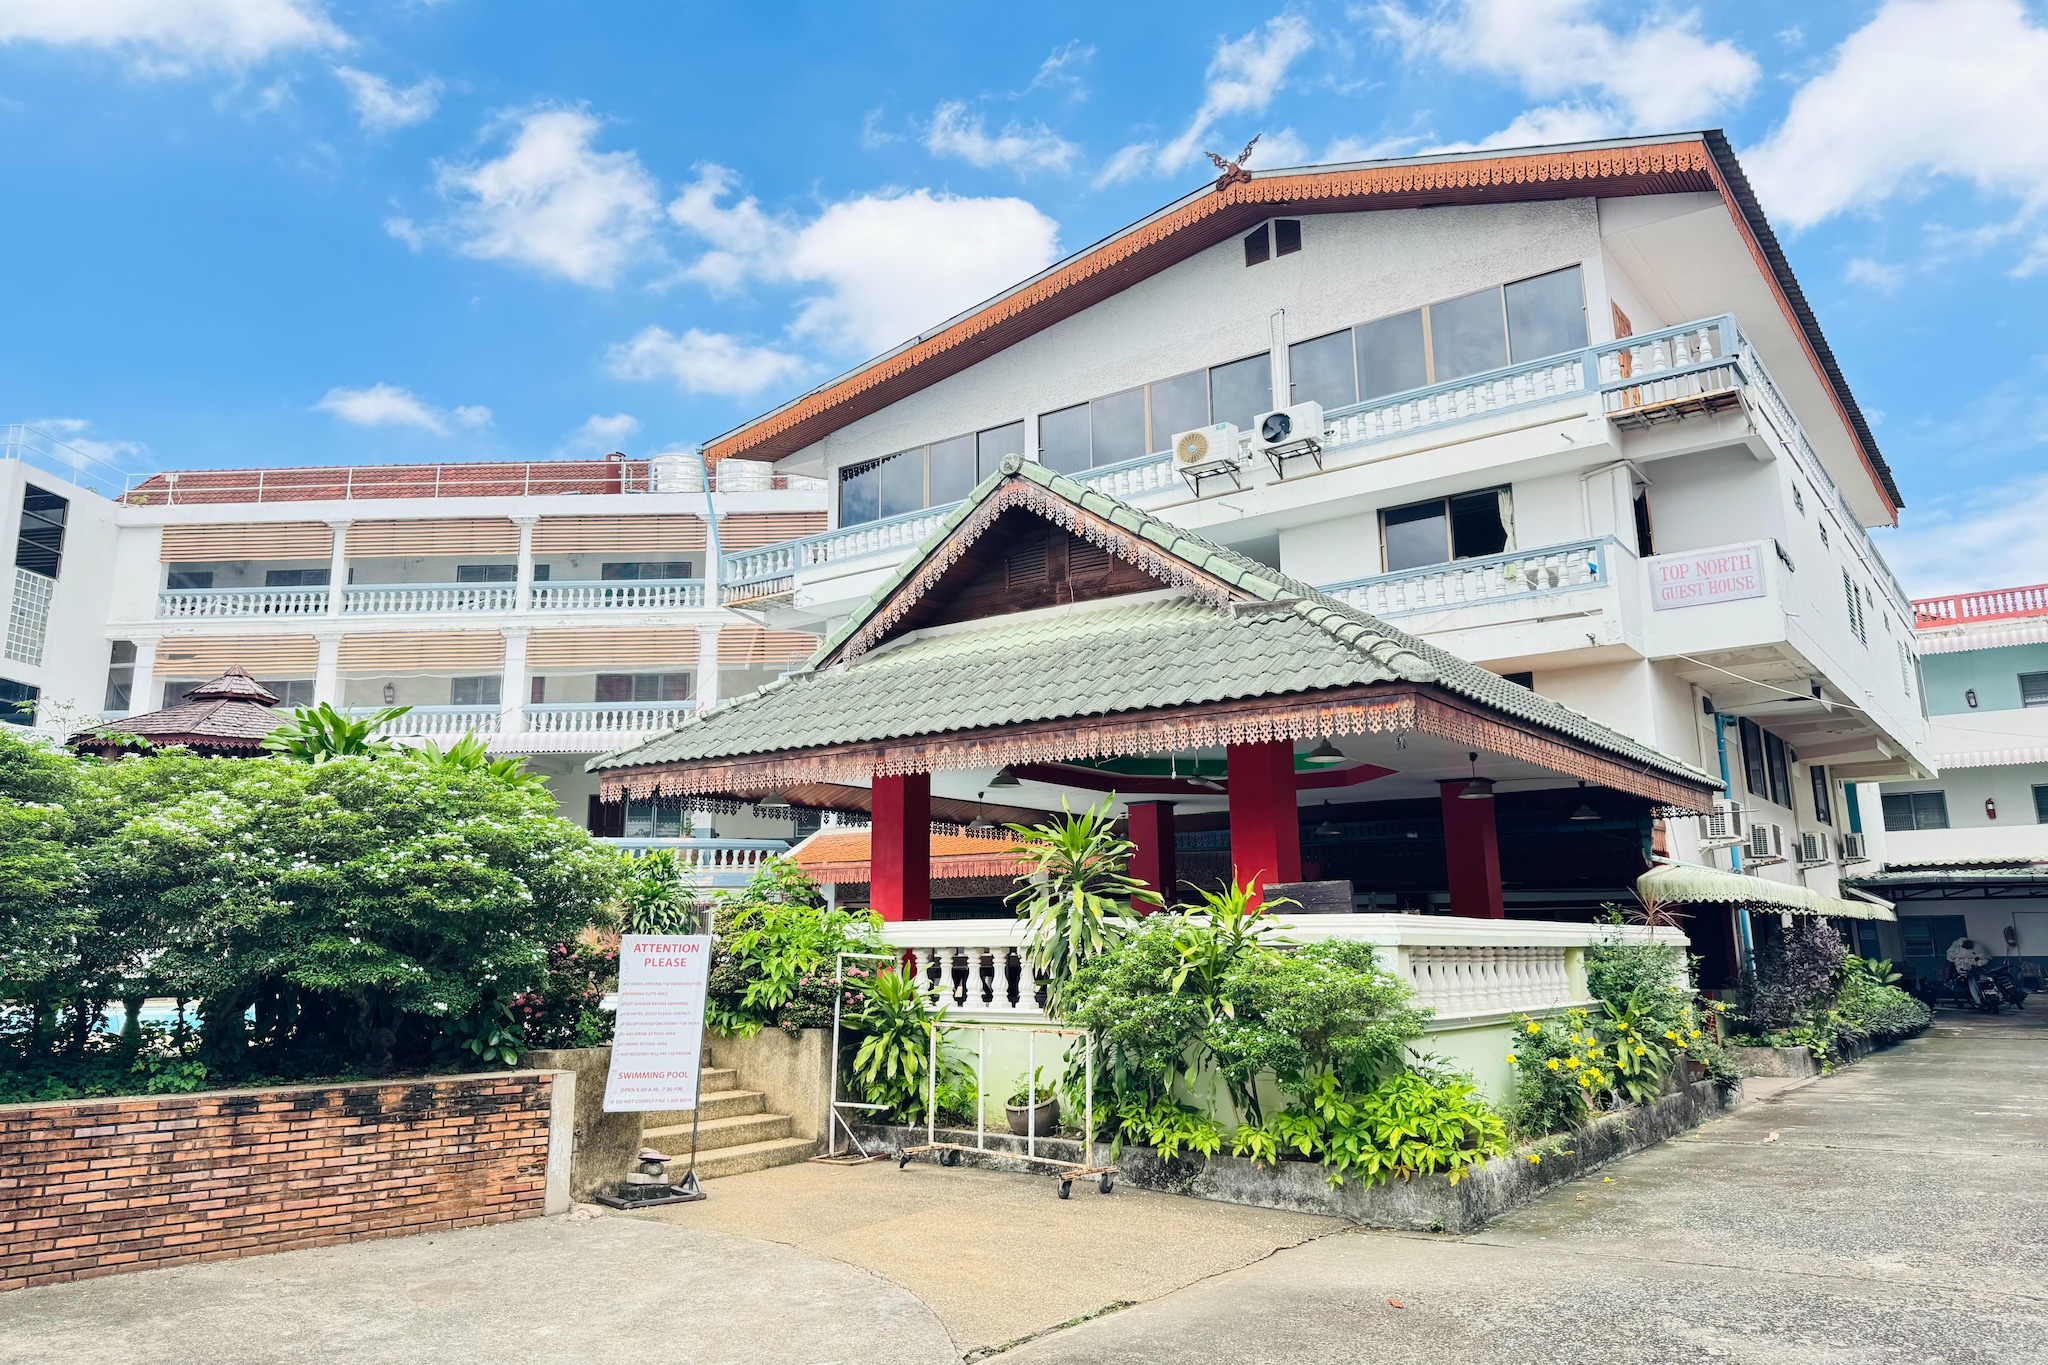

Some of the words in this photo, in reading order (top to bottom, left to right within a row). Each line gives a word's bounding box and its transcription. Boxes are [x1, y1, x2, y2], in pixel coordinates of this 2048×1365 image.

[1659, 563, 1689, 582] TOP
[1696, 554, 1752, 577] NORTH
[1661, 582, 1704, 601] GUEST
[1708, 575, 1755, 594] HOUSE
[633, 943, 700, 953] ATTENTION
[644, 957, 687, 967] PLEASE
[618, 1072, 665, 1080] SWIMMING
